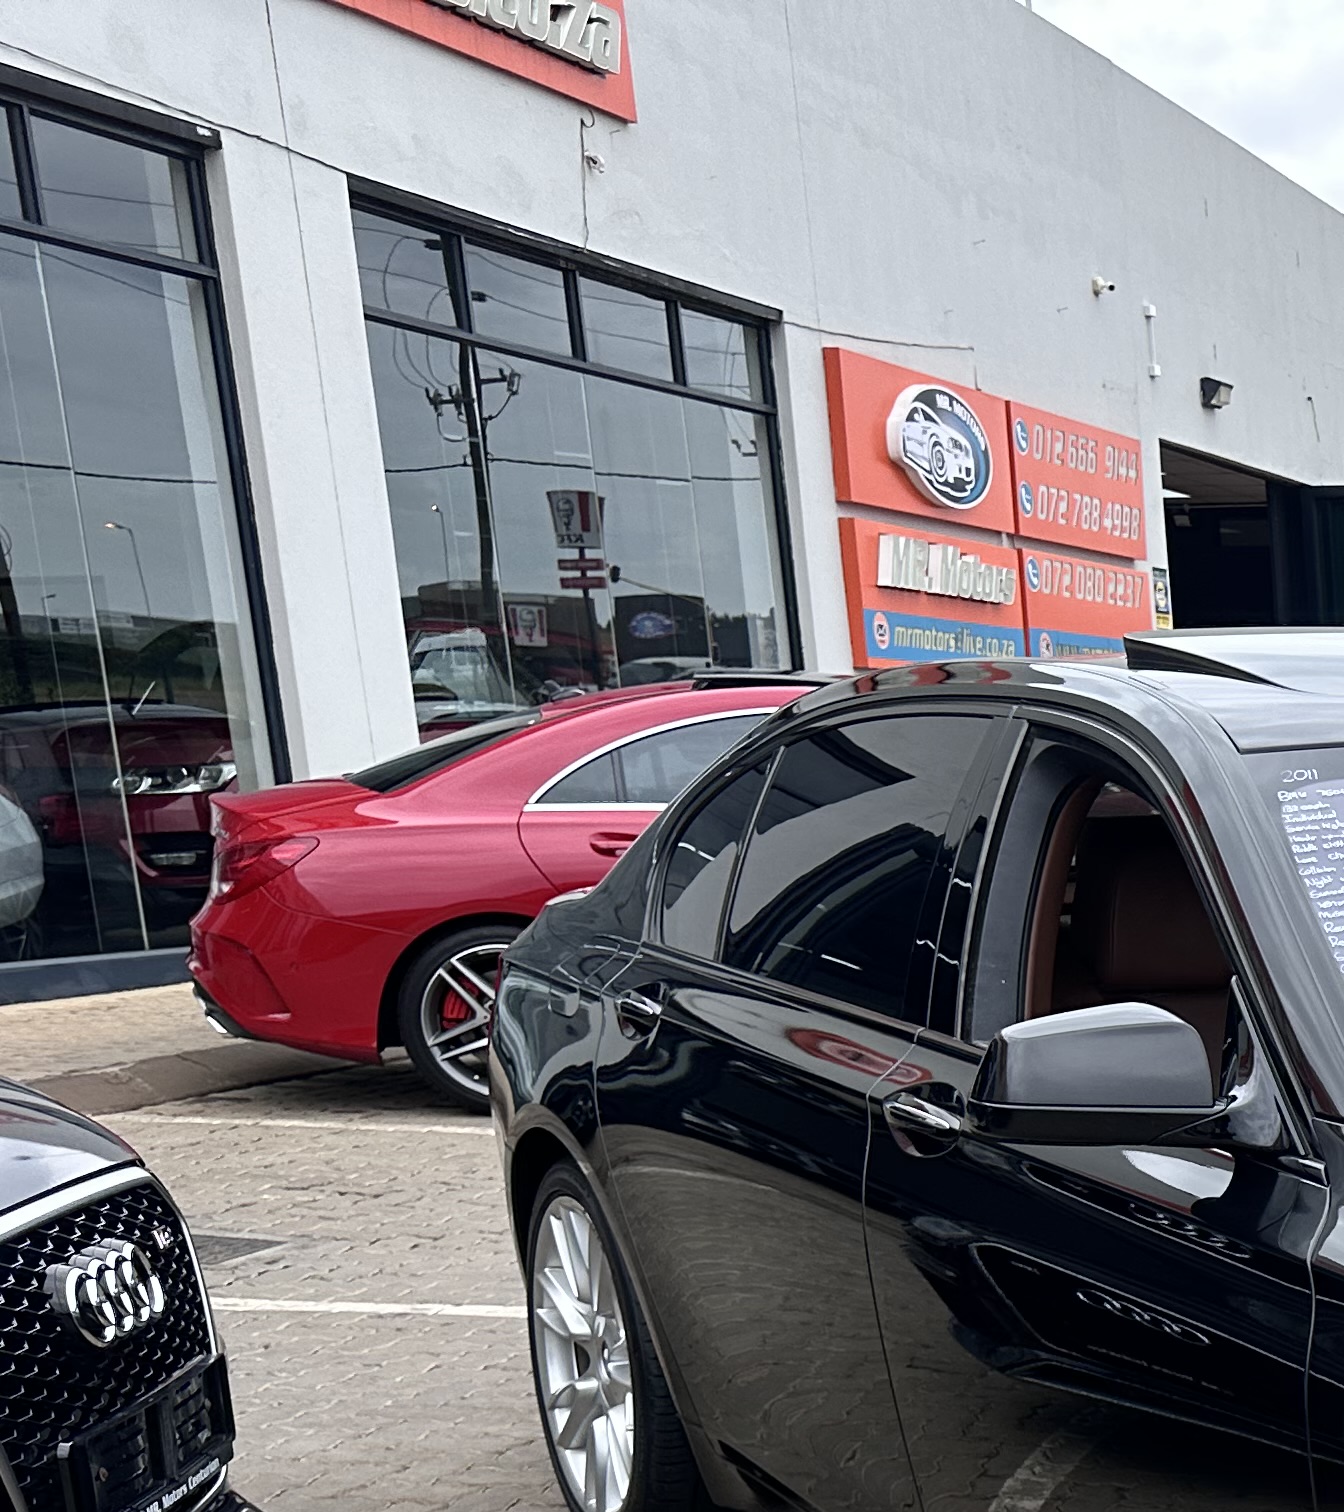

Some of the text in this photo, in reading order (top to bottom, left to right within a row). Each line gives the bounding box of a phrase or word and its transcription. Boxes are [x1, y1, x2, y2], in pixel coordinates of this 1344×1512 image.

[1033, 424, 1138, 485] 012 666 9144
[1037, 485, 1141, 541] 072 788 4998
[877, 533, 1016, 606] MR. Motors
[1041, 559, 1073, 598] 072
[1075, 564, 1104, 603] 080
[1107, 570, 1143, 609] 2237
[894, 624, 1016, 657] mrmotorslive.co.za
[1280, 768, 1318, 782] 2011
[161, 1483, 188, 1510] Motors
[187, 1457, 220, 1490] Centurion
